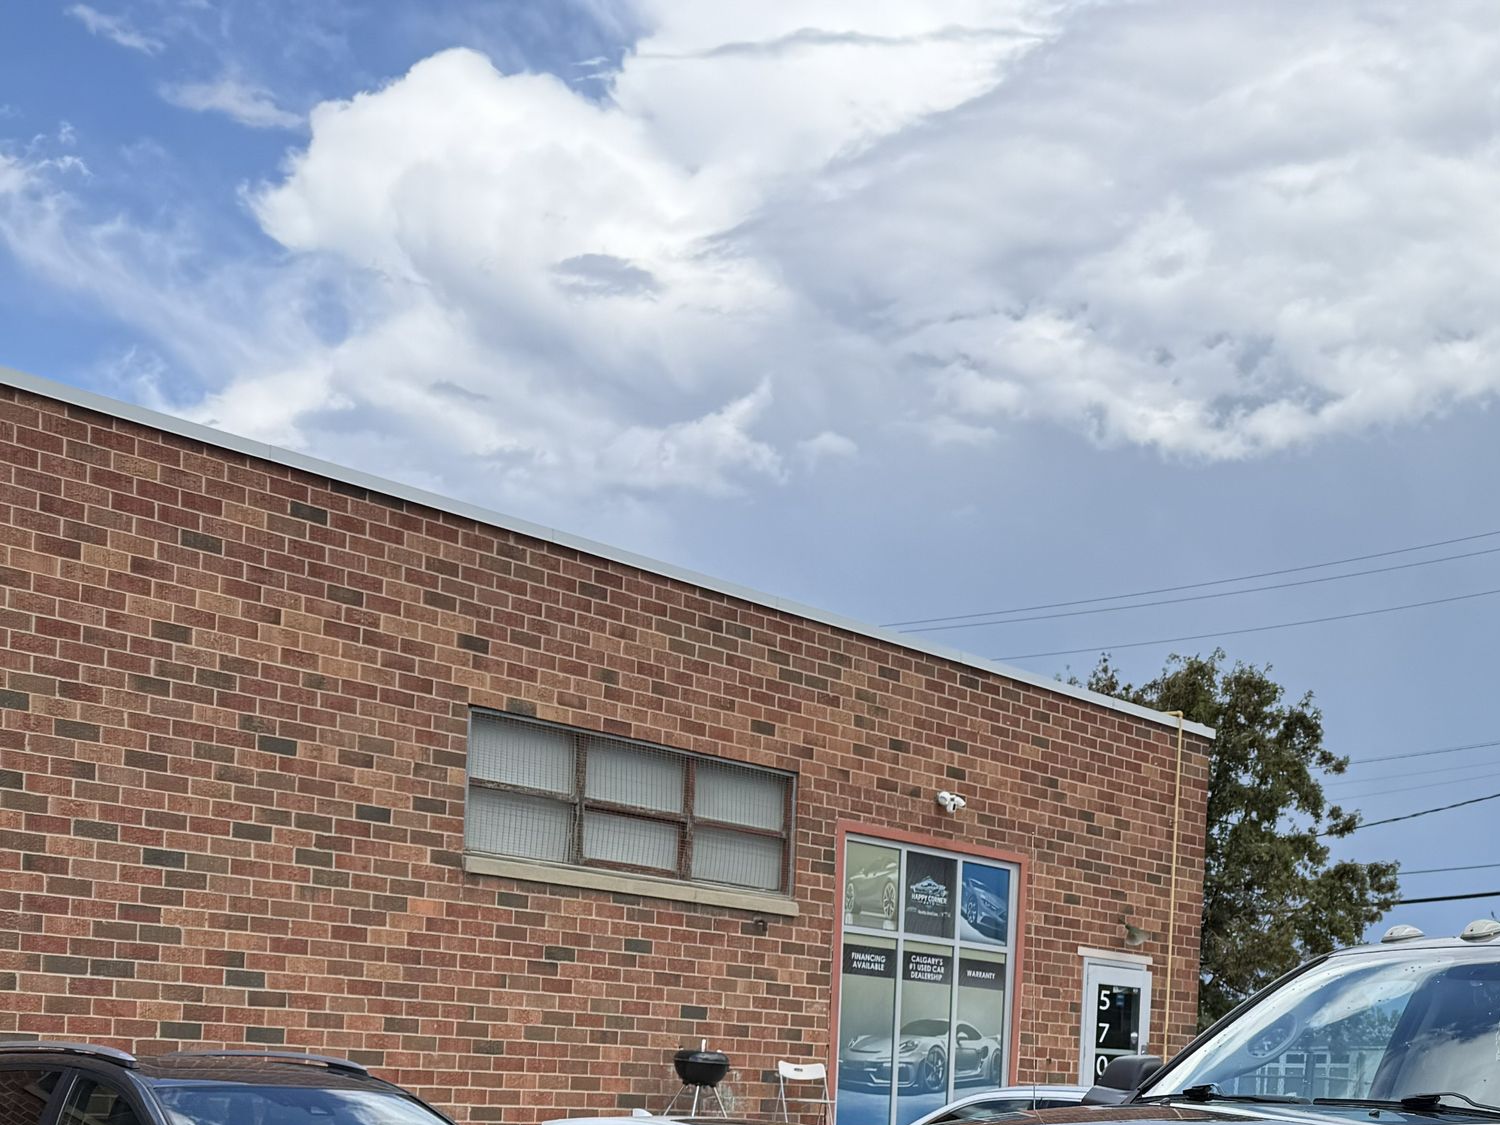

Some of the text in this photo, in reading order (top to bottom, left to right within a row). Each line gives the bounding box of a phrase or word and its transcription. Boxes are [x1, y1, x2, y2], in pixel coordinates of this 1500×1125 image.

[851, 952, 886, 963] FINANCING
[911, 955, 944, 966] CALGARY'S
[852, 961, 885, 971] AVAILABLE
[909, 963, 945, 974] #1 USED CAR
[910, 972, 943, 981] DEALERSHIP
[966, 969, 996, 979] WARRANTY
